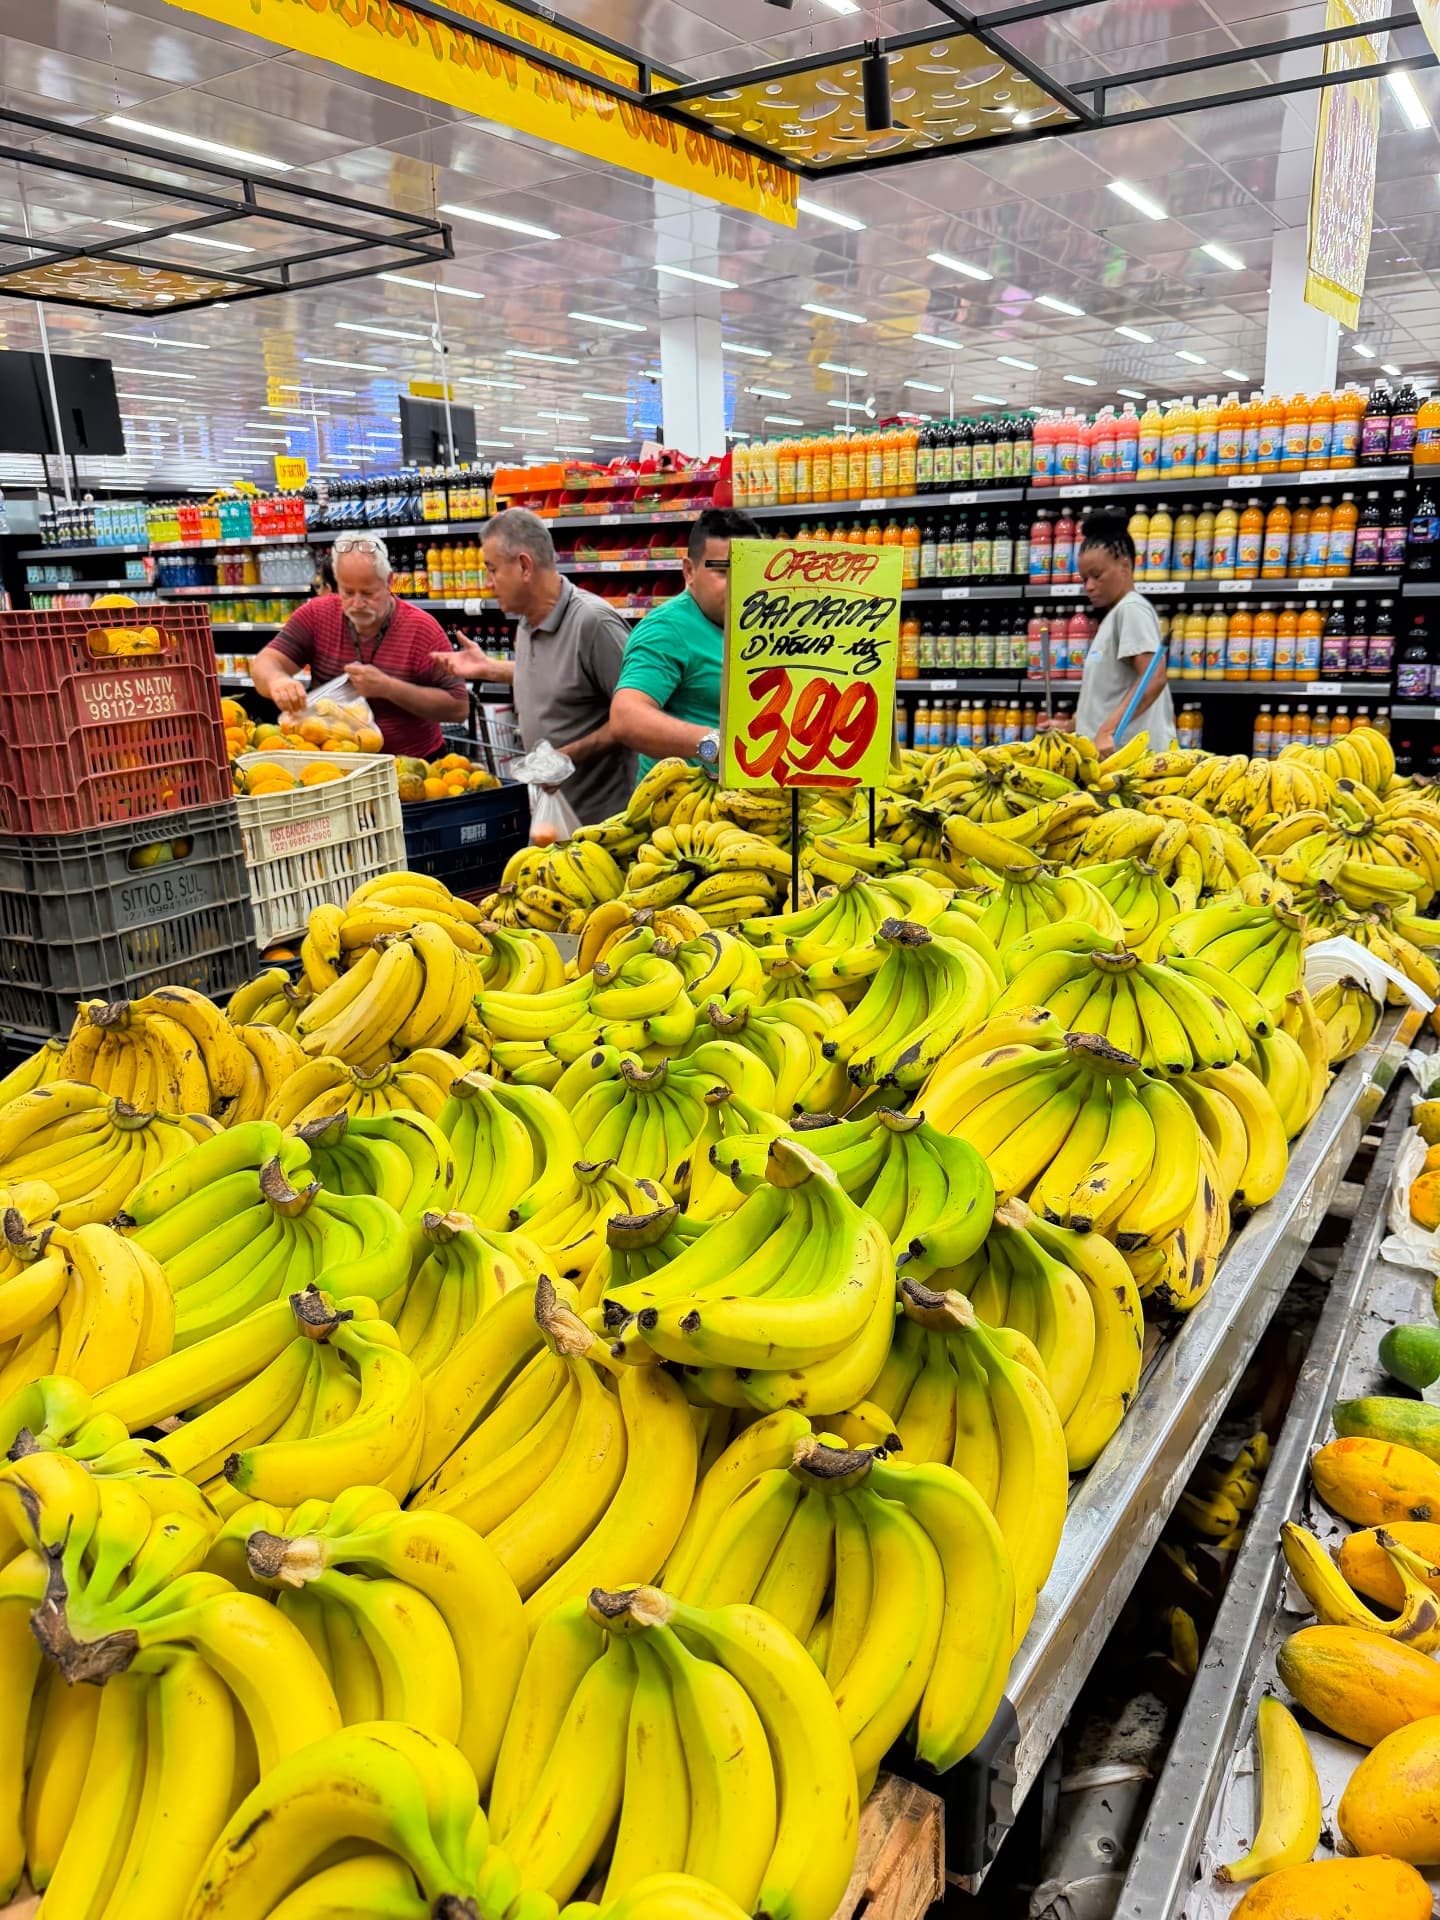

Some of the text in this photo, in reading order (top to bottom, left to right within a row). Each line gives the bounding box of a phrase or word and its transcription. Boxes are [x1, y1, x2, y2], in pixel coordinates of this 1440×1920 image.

[764, 548, 880, 586] OFERTA
[738, 590, 897, 632] BANANA
[81, 675, 177, 703] LUCAS NATIV.
[89, 693, 177, 720] 98112-2331
[120, 882, 161, 911] SITIO
